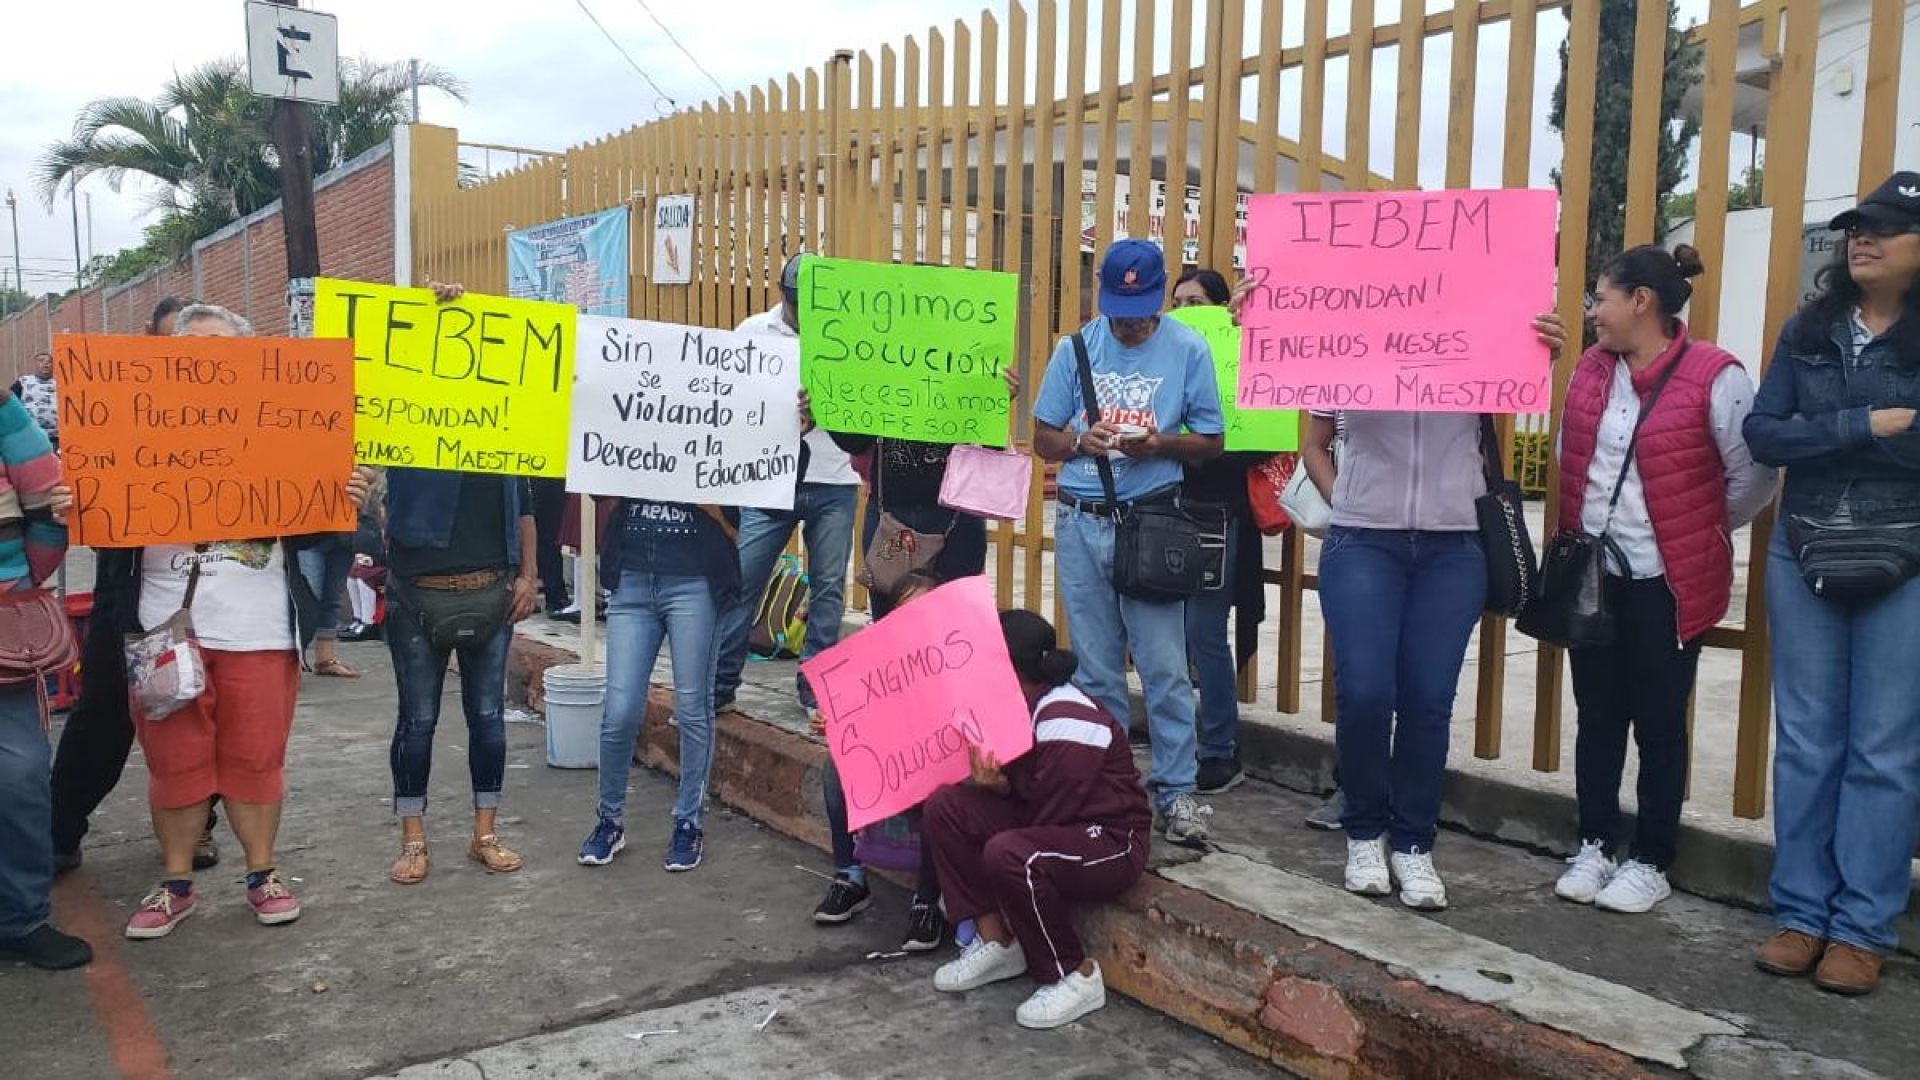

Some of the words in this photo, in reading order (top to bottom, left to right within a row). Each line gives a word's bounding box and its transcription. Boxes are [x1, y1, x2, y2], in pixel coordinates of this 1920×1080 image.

[1290, 197, 1490, 254] IEBEM
[811, 264, 998, 333] Exigimos
[336, 293, 562, 392] IEBEM
[602, 327, 652, 364] Sin
[681, 331, 783, 376] Maestro
[1247, 326, 1369, 363] TENEMOS
[1384, 330, 1470, 355] MESES
[638, 370, 662, 390] se
[687, 375, 734, 396] esta
[65, 390, 109, 428] NO
[134, 392, 238, 429] PUEDEN
[257, 400, 346, 431] ESTAR
[354, 395, 509, 431] ESPONDAN!
[612, 391, 733, 427] Violando
[746, 400, 766, 426] el
[820, 401, 982, 438] PROFESOR
[66, 445, 116, 471] SIN
[354, 440, 415, 465] GIMOS
[437, 436, 547, 471] MAESTRO
[583, 431, 678, 473] Derecho
[685, 440, 697, 456] a
[706, 434, 722, 456] la
[695, 444, 796, 489] Educación
[76, 476, 353, 545] RESPONDAN
[820, 630, 975, 723] EXIGIMOS
[841, 708, 985, 810] SOLUCIÓN
